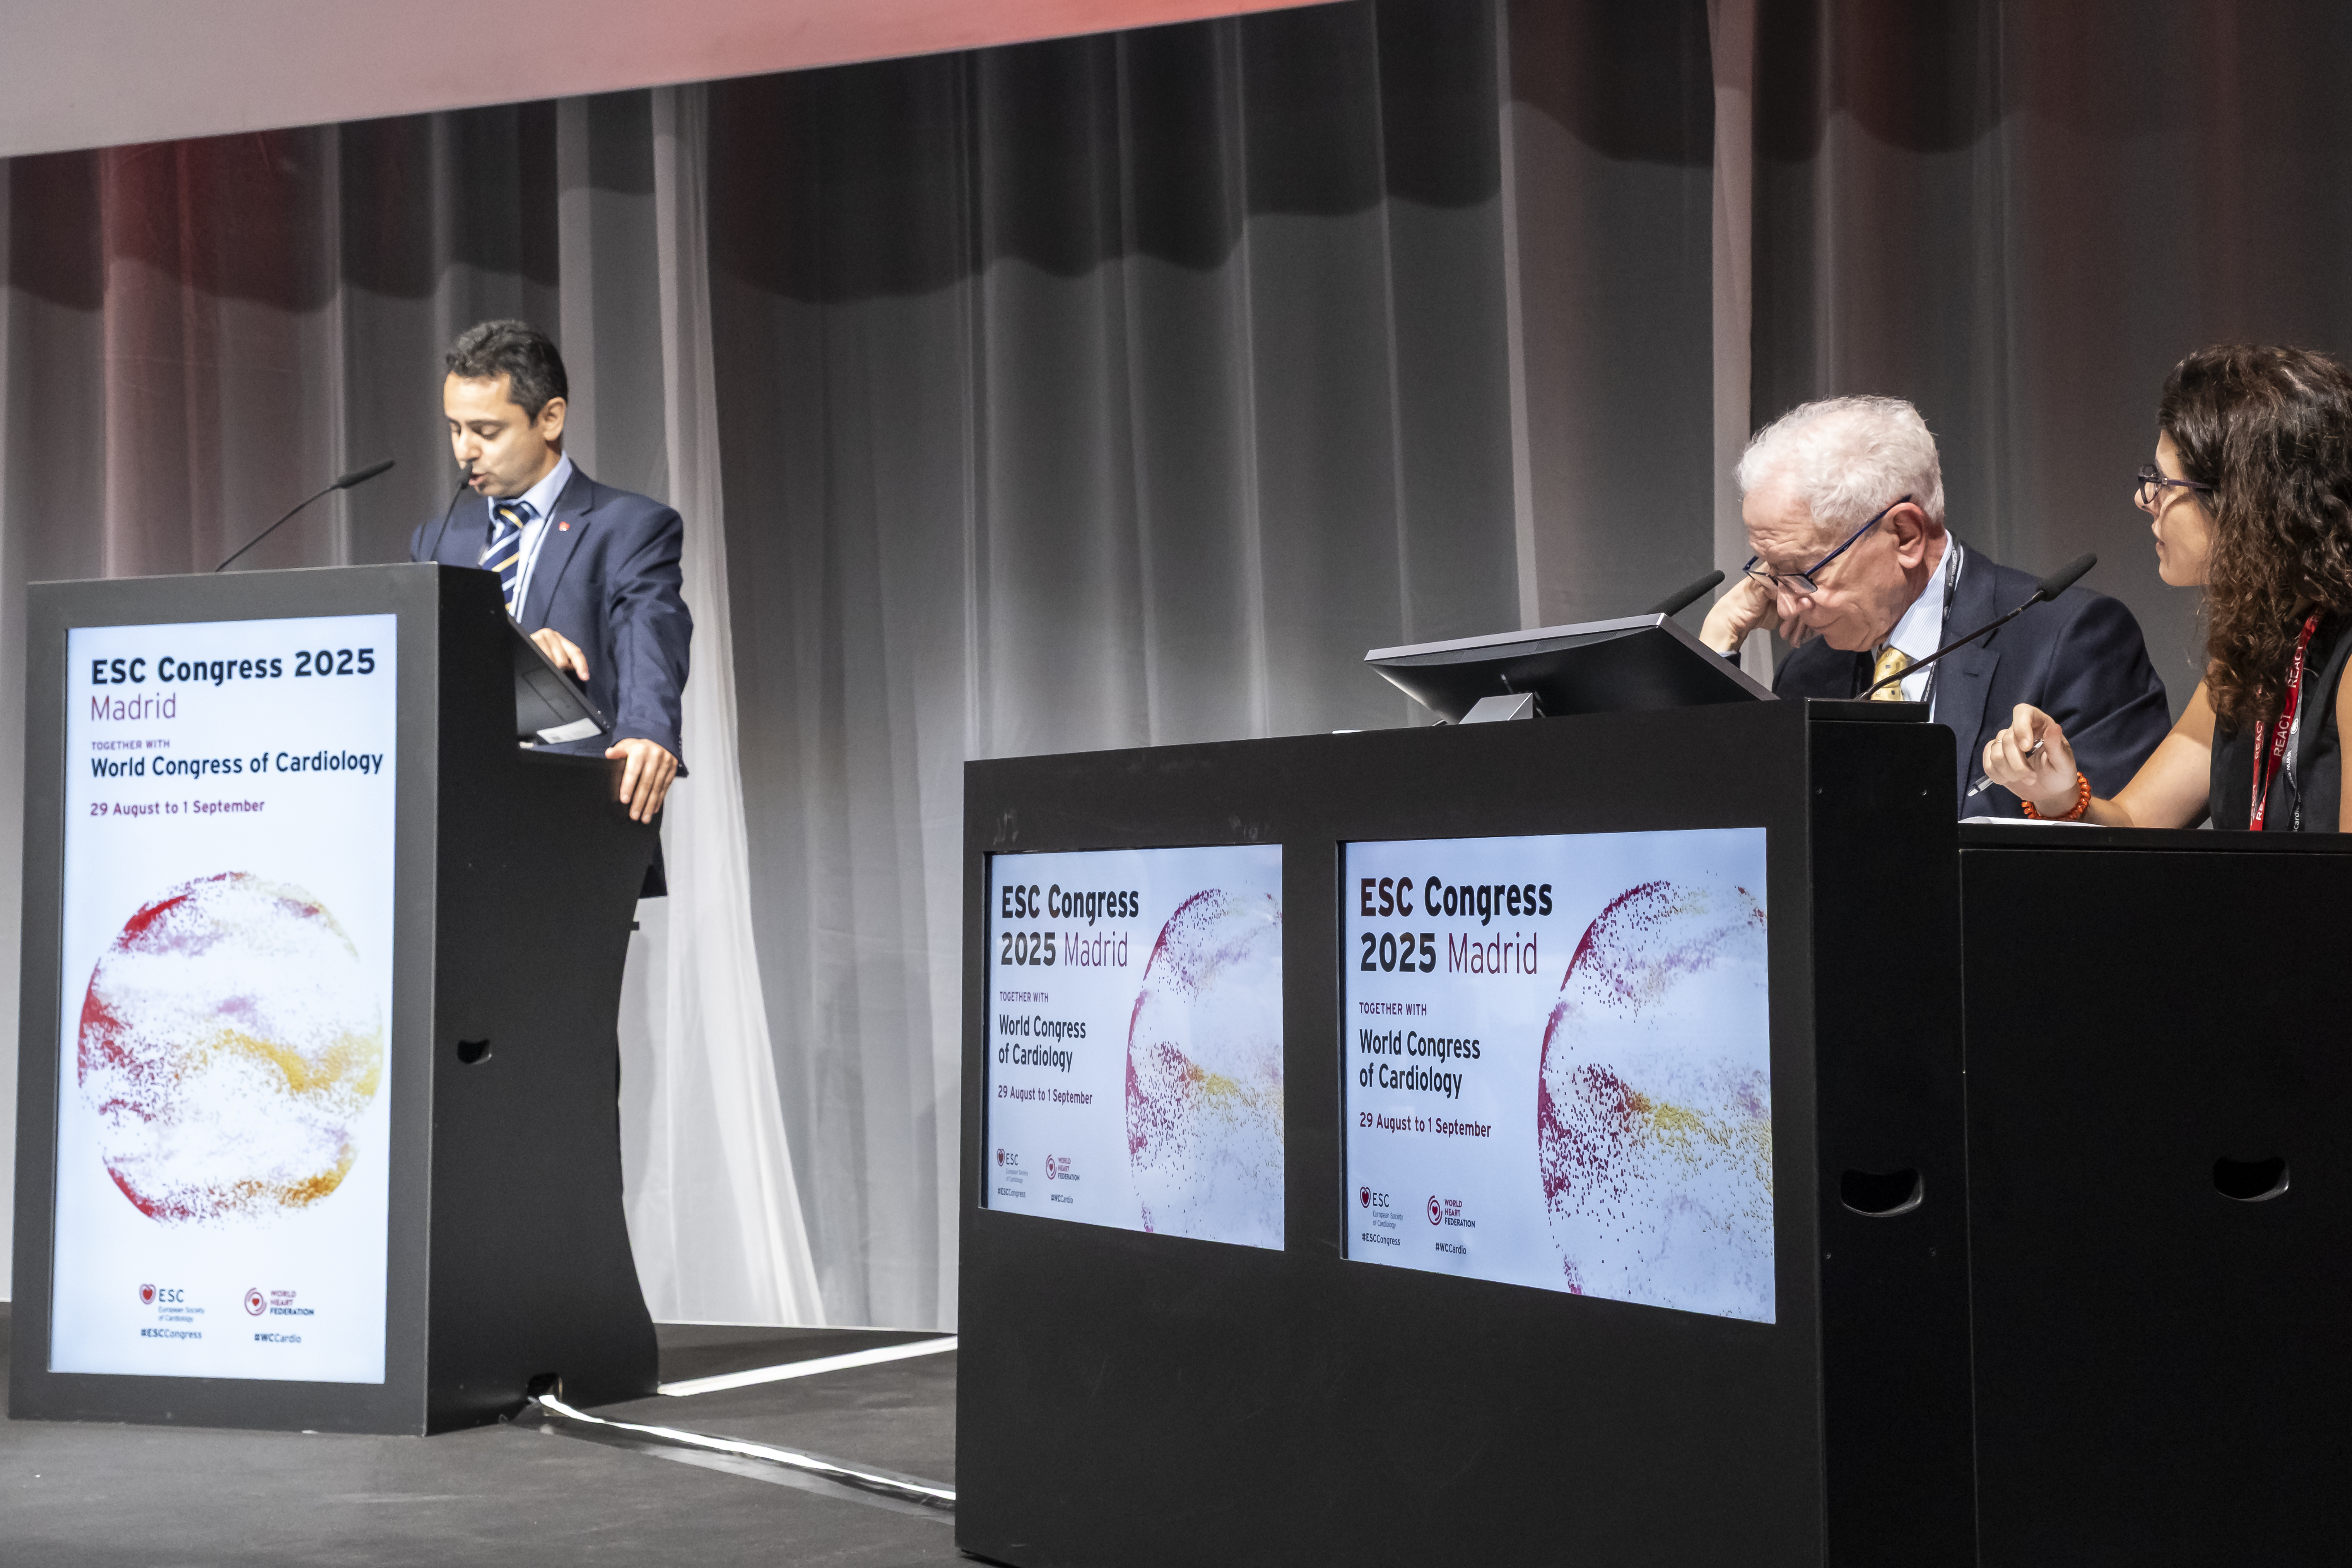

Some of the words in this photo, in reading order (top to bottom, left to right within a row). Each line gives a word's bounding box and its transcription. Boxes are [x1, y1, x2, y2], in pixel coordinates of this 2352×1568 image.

[92, 658, 146, 685] ESC
[158, 657, 282, 687] Congress
[295, 648, 375, 677] 2025
[91, 693, 176, 721] Madrid
[91, 740, 142, 751] TOGETHER
[146, 739, 169, 748] WITH
[91, 757, 144, 778] World
[152, 756, 242, 779] Congress
[250, 752, 268, 773] of
[276, 750, 383, 774] Cardiology
[90, 803, 108, 816] 29
[113, 802, 159, 817] August
[165, 802, 178, 814] to
[183, 801, 187, 813] 1
[193, 800, 265, 815] September
[1002, 885, 1040, 918] ESC
[1048, 884, 1138, 927] Congress
[1361, 877, 1413, 917] ESC
[1425, 876, 1552, 926] Congress
[1001, 932, 1056, 966] 2025
[1065, 931, 1127, 967] Madrid
[1361, 932, 1436, 973] 2025
[1449, 931, 1537, 974] Madrid
[1000, 992, 1031, 1002] TOGETHER
[1033, 992, 1048, 1002] WITH
[1359, 1002, 1402, 1015] TOGETHER
[1406, 1004, 1426, 1016] WITH
[999, 1014, 1029, 1036] World
[1034, 1016, 1085, 1043] Congress
[1359, 1029, 1401, 1055] World
[1407, 1031, 1480, 1064] Congress
[999, 1043, 1009, 1064] of
[1013, 1043, 1072, 1072] Cardiology
[1360, 1062, 1374, 1087] of
[1379, 1062, 1462, 1099] Cardiology
[998, 1085, 1007, 1098] 29
[1010, 1086, 1035, 1101] August
[1038, 1088, 1045, 1101] to
[1048, 1089, 1050, 1101] 1
[1053, 1089, 1092, 1105] September
[1360, 1112, 1373, 1127] 29
[1376, 1113, 1411, 1134] August
[1415, 1116, 1425, 1132] to
[1428, 1117, 1431, 1132] 1
[1436, 1118, 1491, 1138] September
[1006, 1153, 1018, 1166] ESC
[1373, 1193, 1389, 1207] ESC
[1444, 1199, 1462, 1207] WORLD
[1445, 1208, 1460, 1217] HEART
[1445, 1217, 1475, 1228] FEDERATION
[1362, 1233, 1400, 1246] #ESCCongress
[1436, 1243, 1466, 1255] #WCCardio
[159, 1289, 183, 1303] ESC
